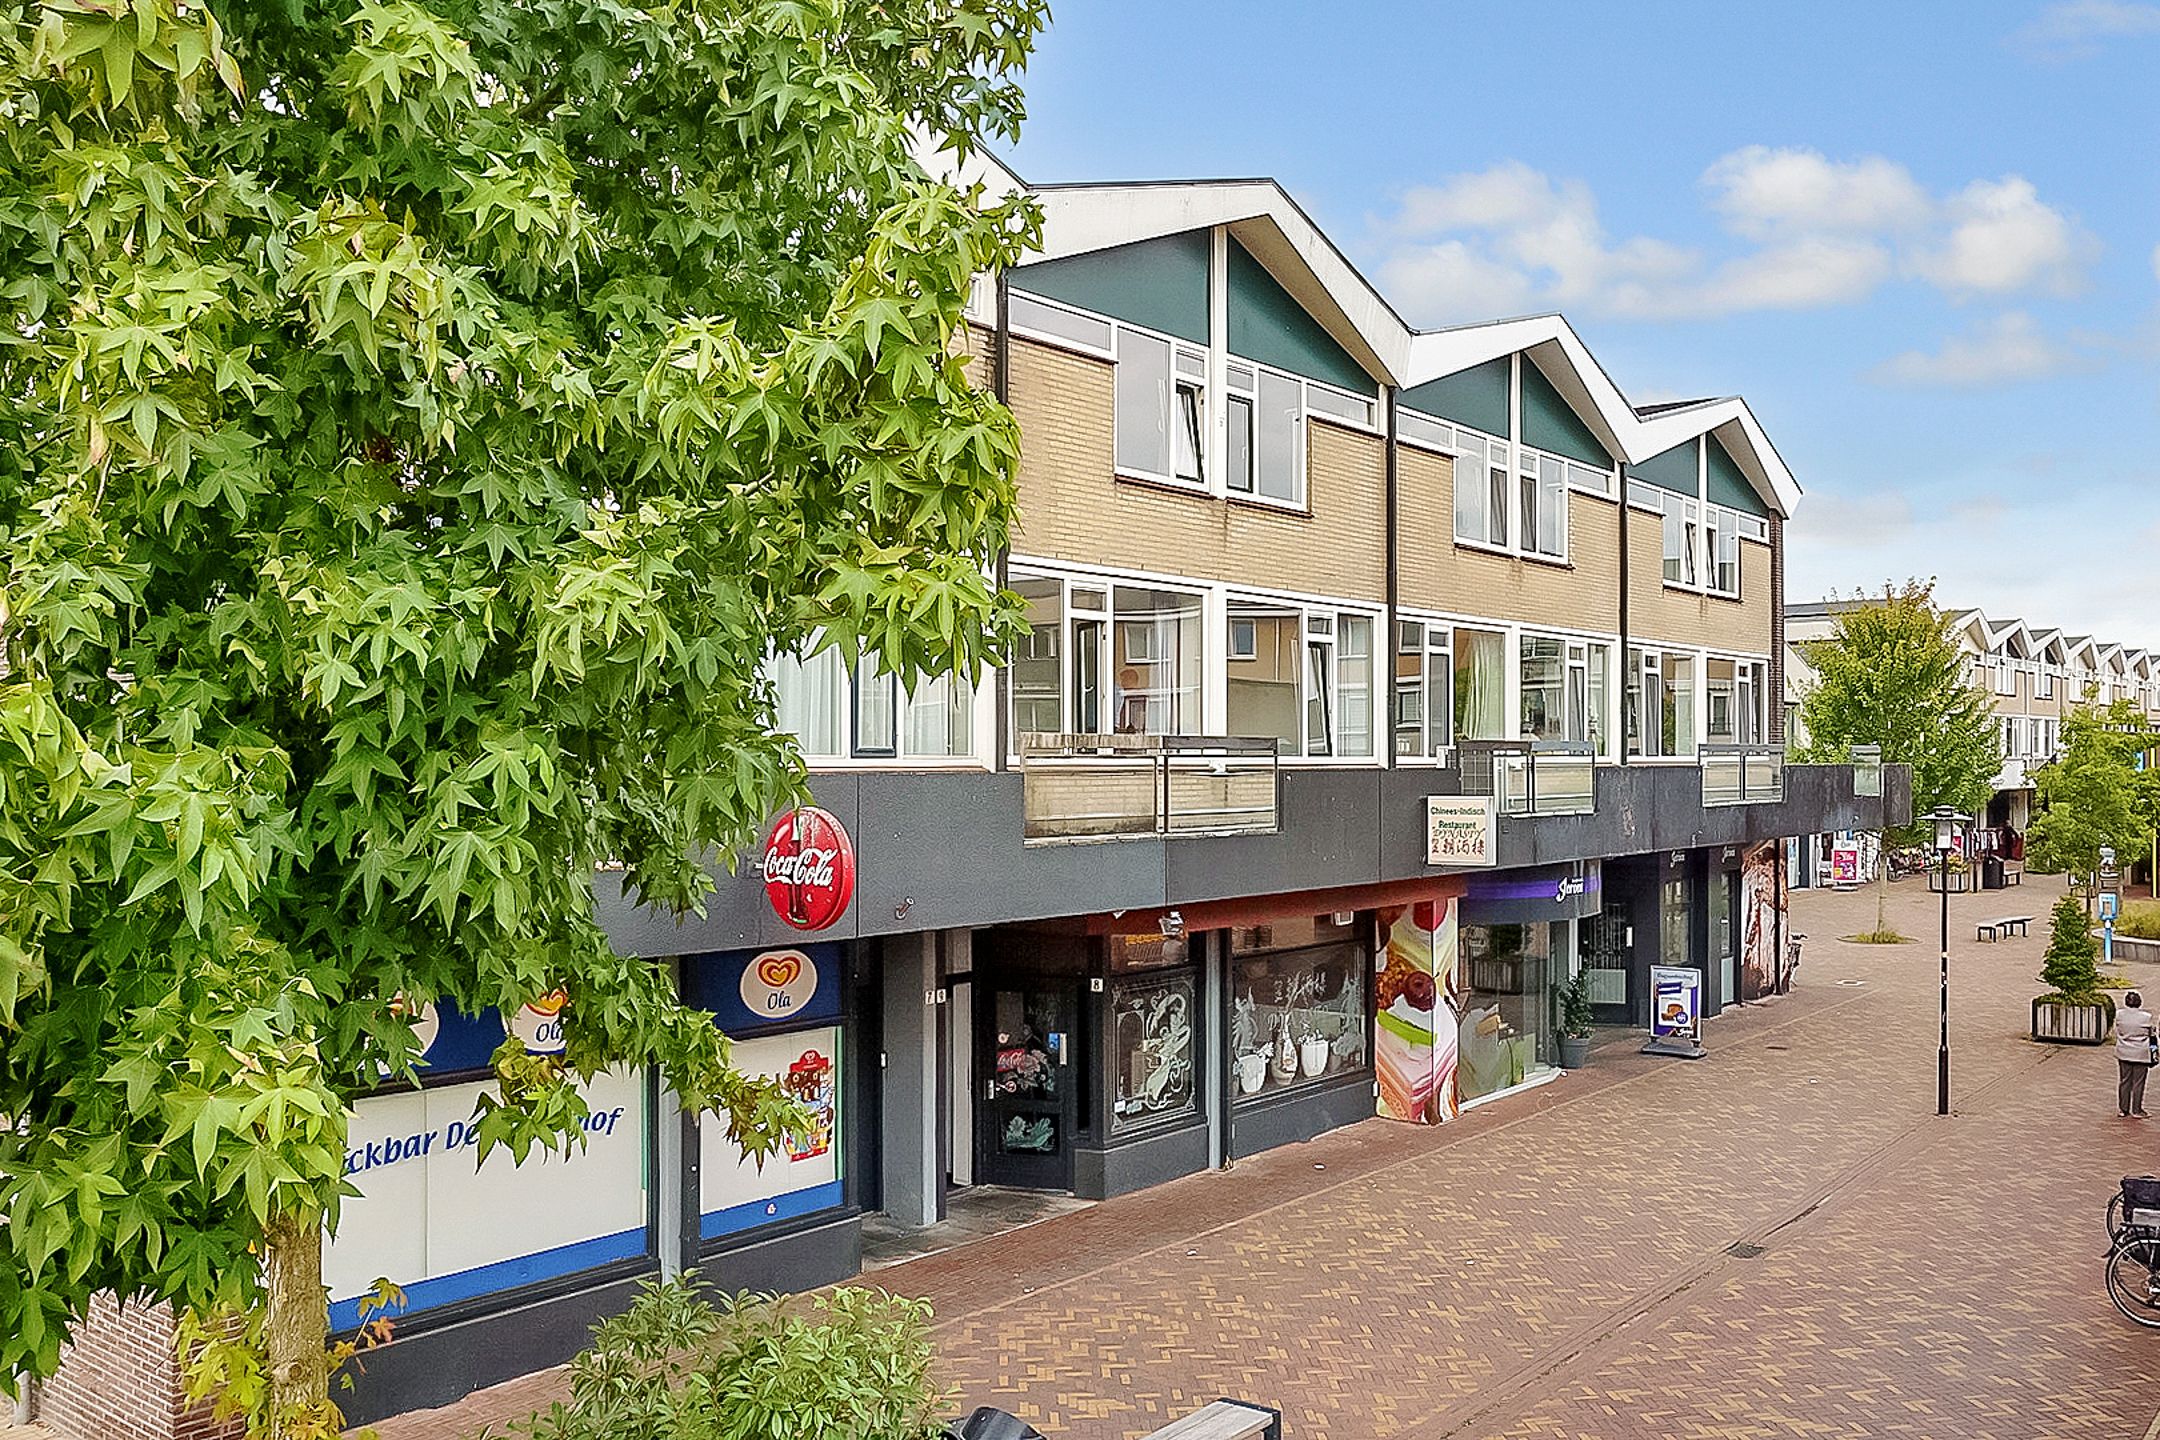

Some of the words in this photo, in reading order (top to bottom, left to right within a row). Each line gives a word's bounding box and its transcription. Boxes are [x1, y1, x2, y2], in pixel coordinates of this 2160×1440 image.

[1438, 819, 1477, 829] Restaurant
[763, 846, 838, 887] Coca-Cola
[767, 990, 792, 1010] Ola
[347, 1131, 438, 1174] ckbar
